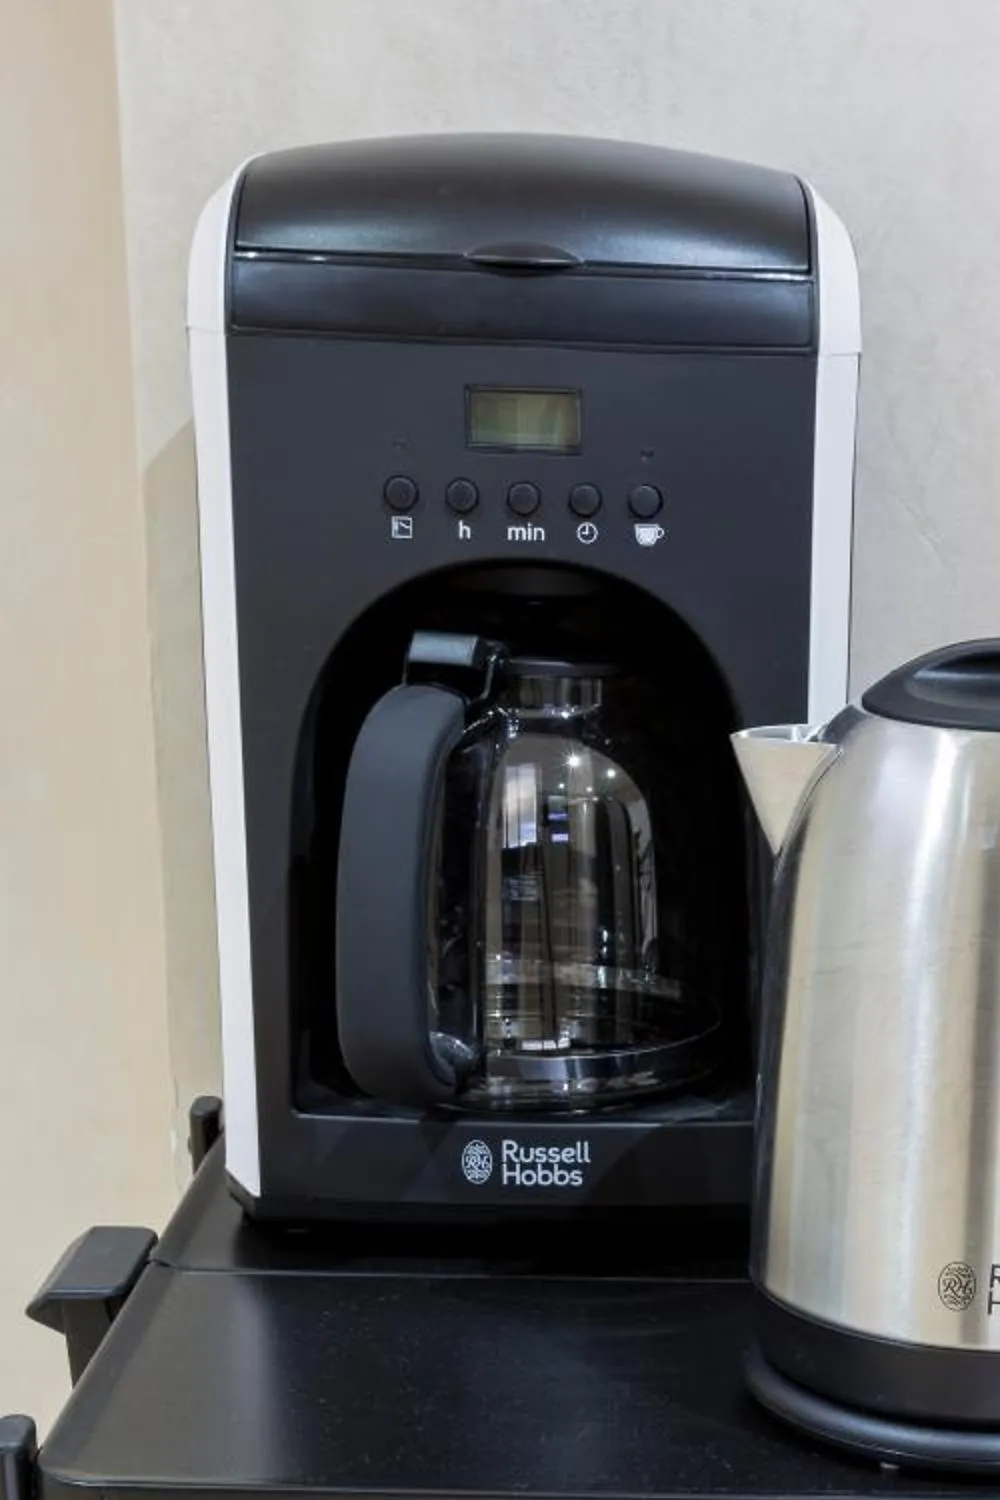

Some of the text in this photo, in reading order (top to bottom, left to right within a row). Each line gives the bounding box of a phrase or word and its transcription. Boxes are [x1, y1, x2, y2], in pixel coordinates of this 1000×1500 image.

[458, 520, 471, 539] h
[507, 522, 545, 542] min
[501, 1139, 591, 1163] Russell
[502, 1163, 583, 1186] Hobbs
